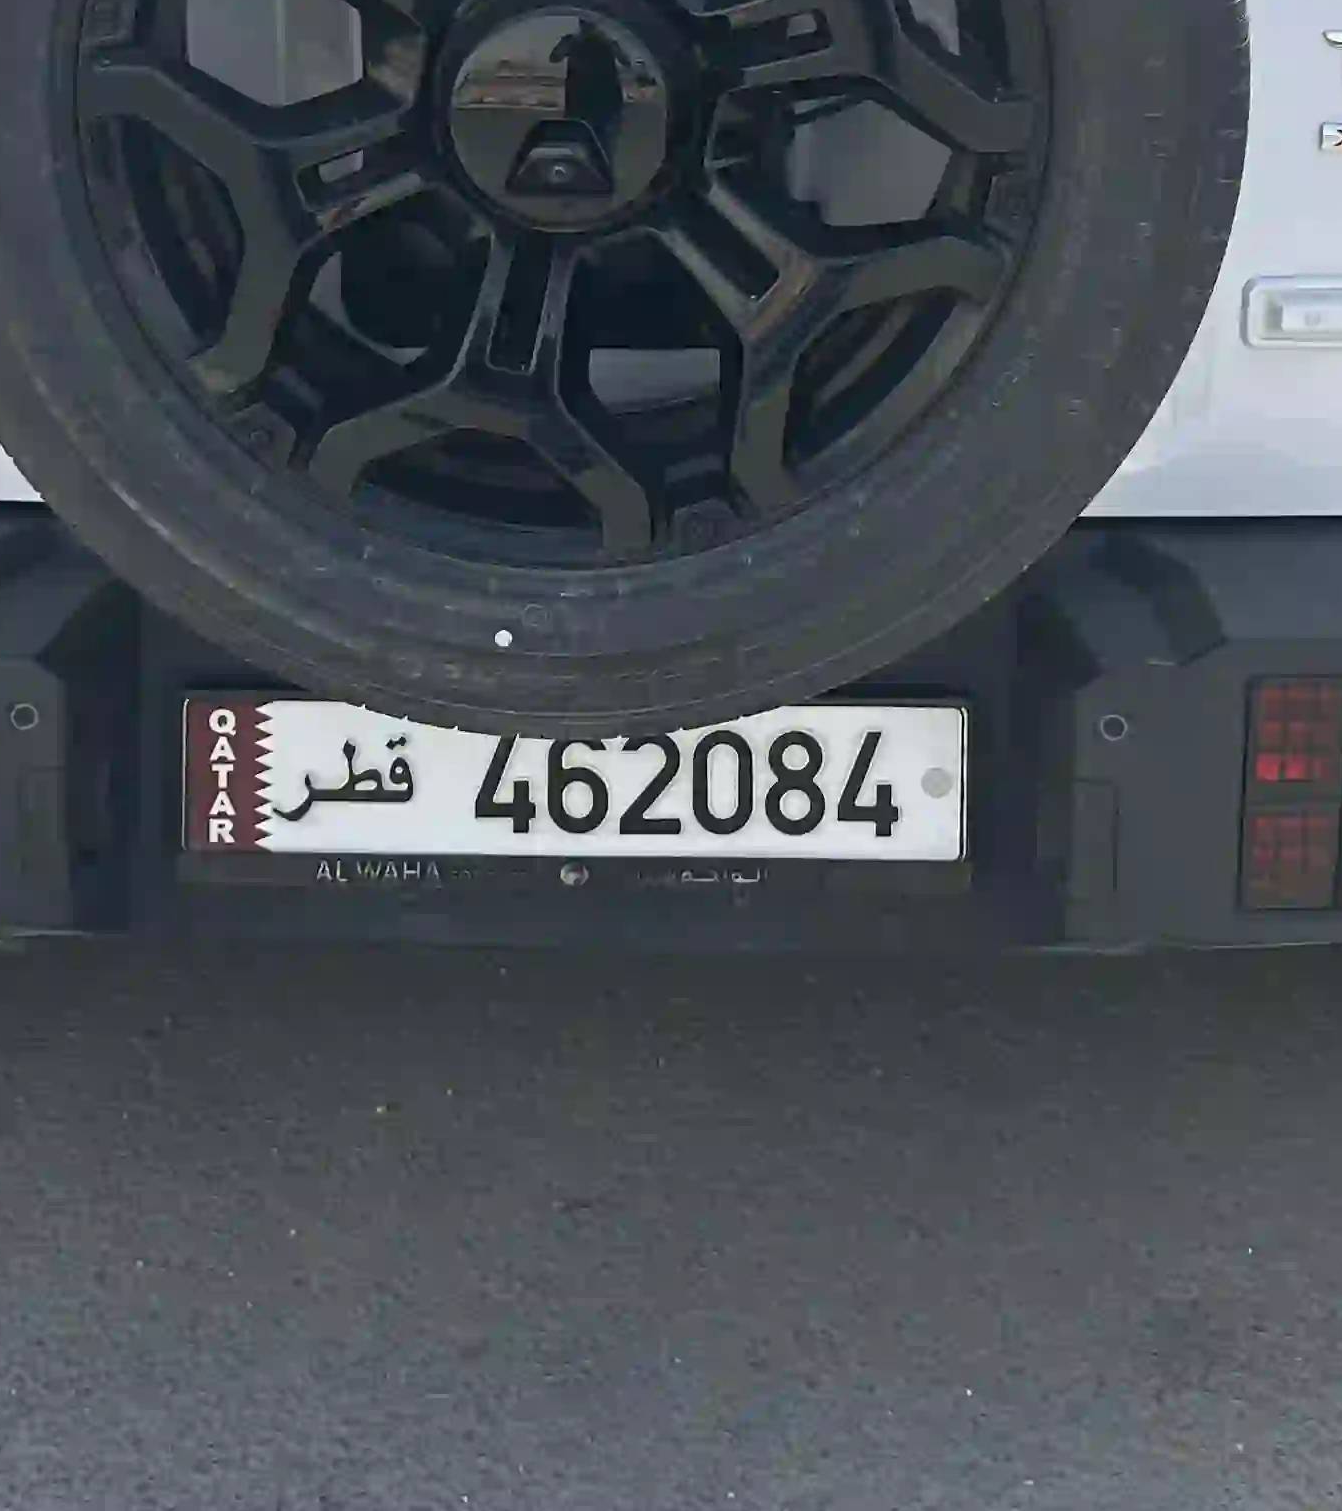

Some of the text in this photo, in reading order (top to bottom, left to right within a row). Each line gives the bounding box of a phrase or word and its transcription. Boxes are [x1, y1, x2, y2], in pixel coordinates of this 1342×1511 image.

[208, 708, 237, 844] QATAR
[272, 735, 414, 822] قطر
[474, 729, 900, 838] 462084
[316, 859, 349, 882] AL
